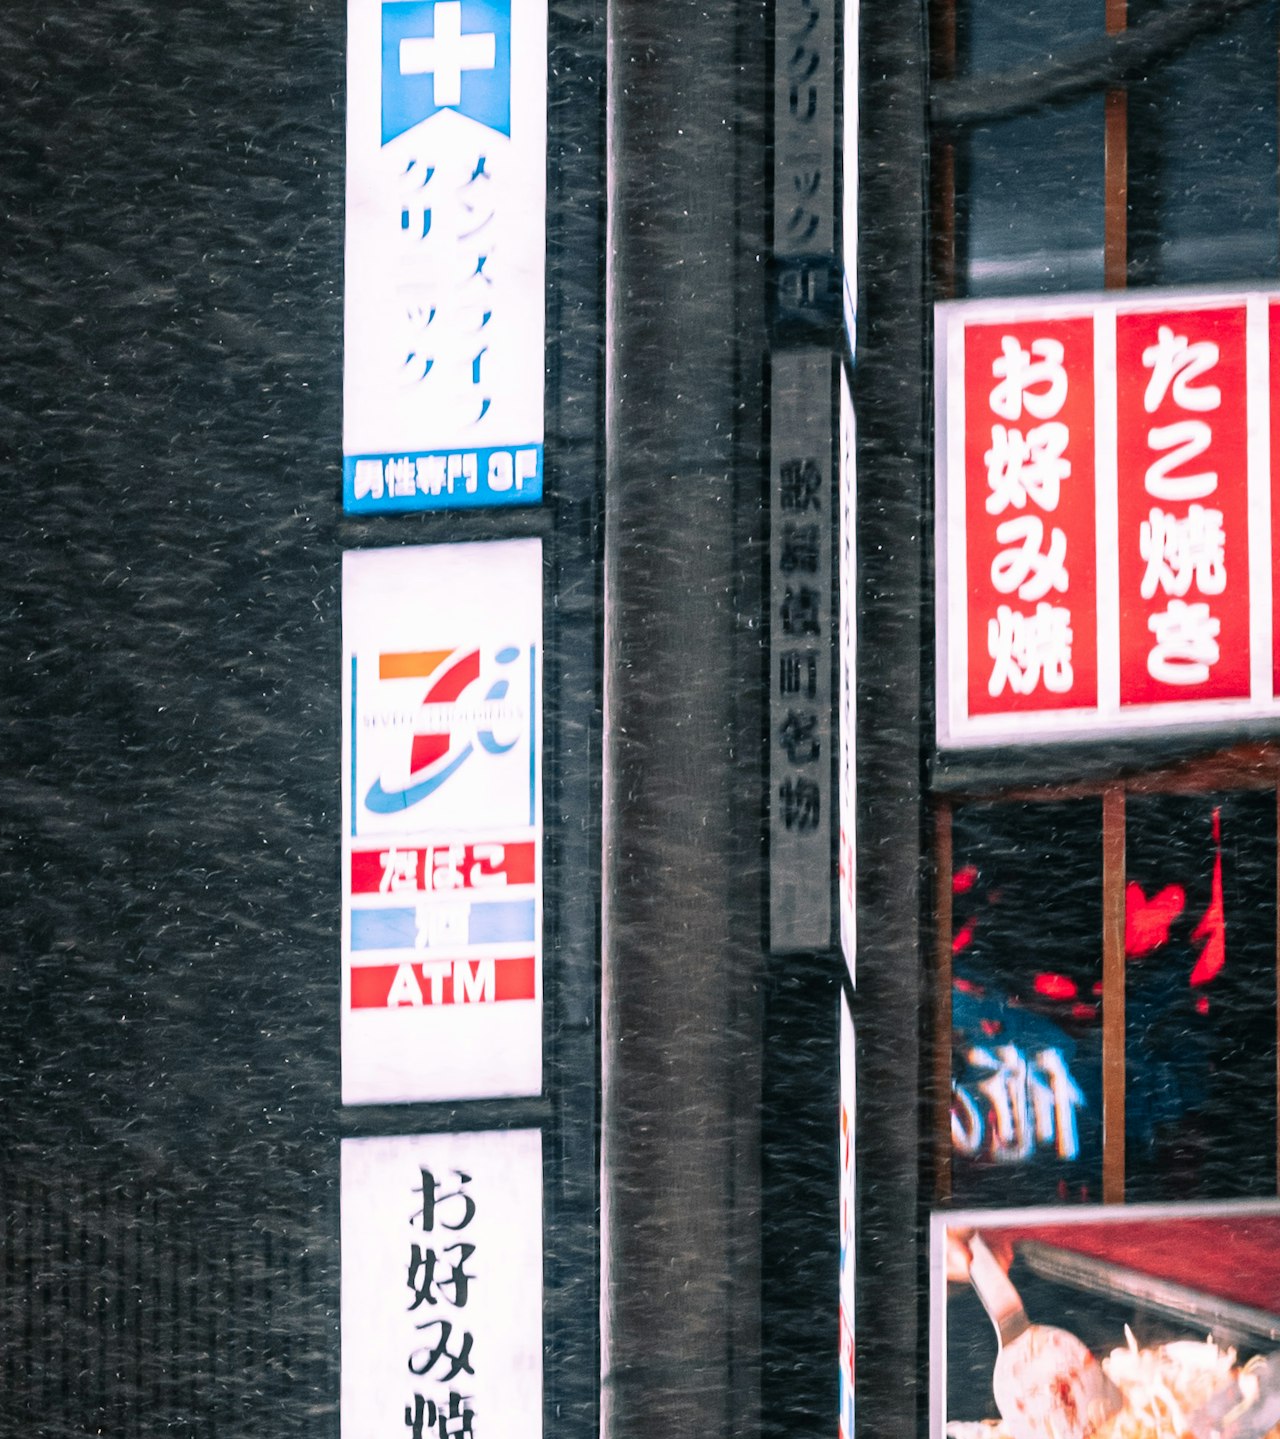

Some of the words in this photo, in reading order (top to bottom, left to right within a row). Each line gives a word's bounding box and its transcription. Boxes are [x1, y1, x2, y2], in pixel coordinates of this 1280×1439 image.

[986, 335, 1073, 698] お好み焼
[1139, 326, 1226, 686] たこ焼き
[379, 842, 506, 893] たばこ
[387, 958, 495, 1008] ATM
